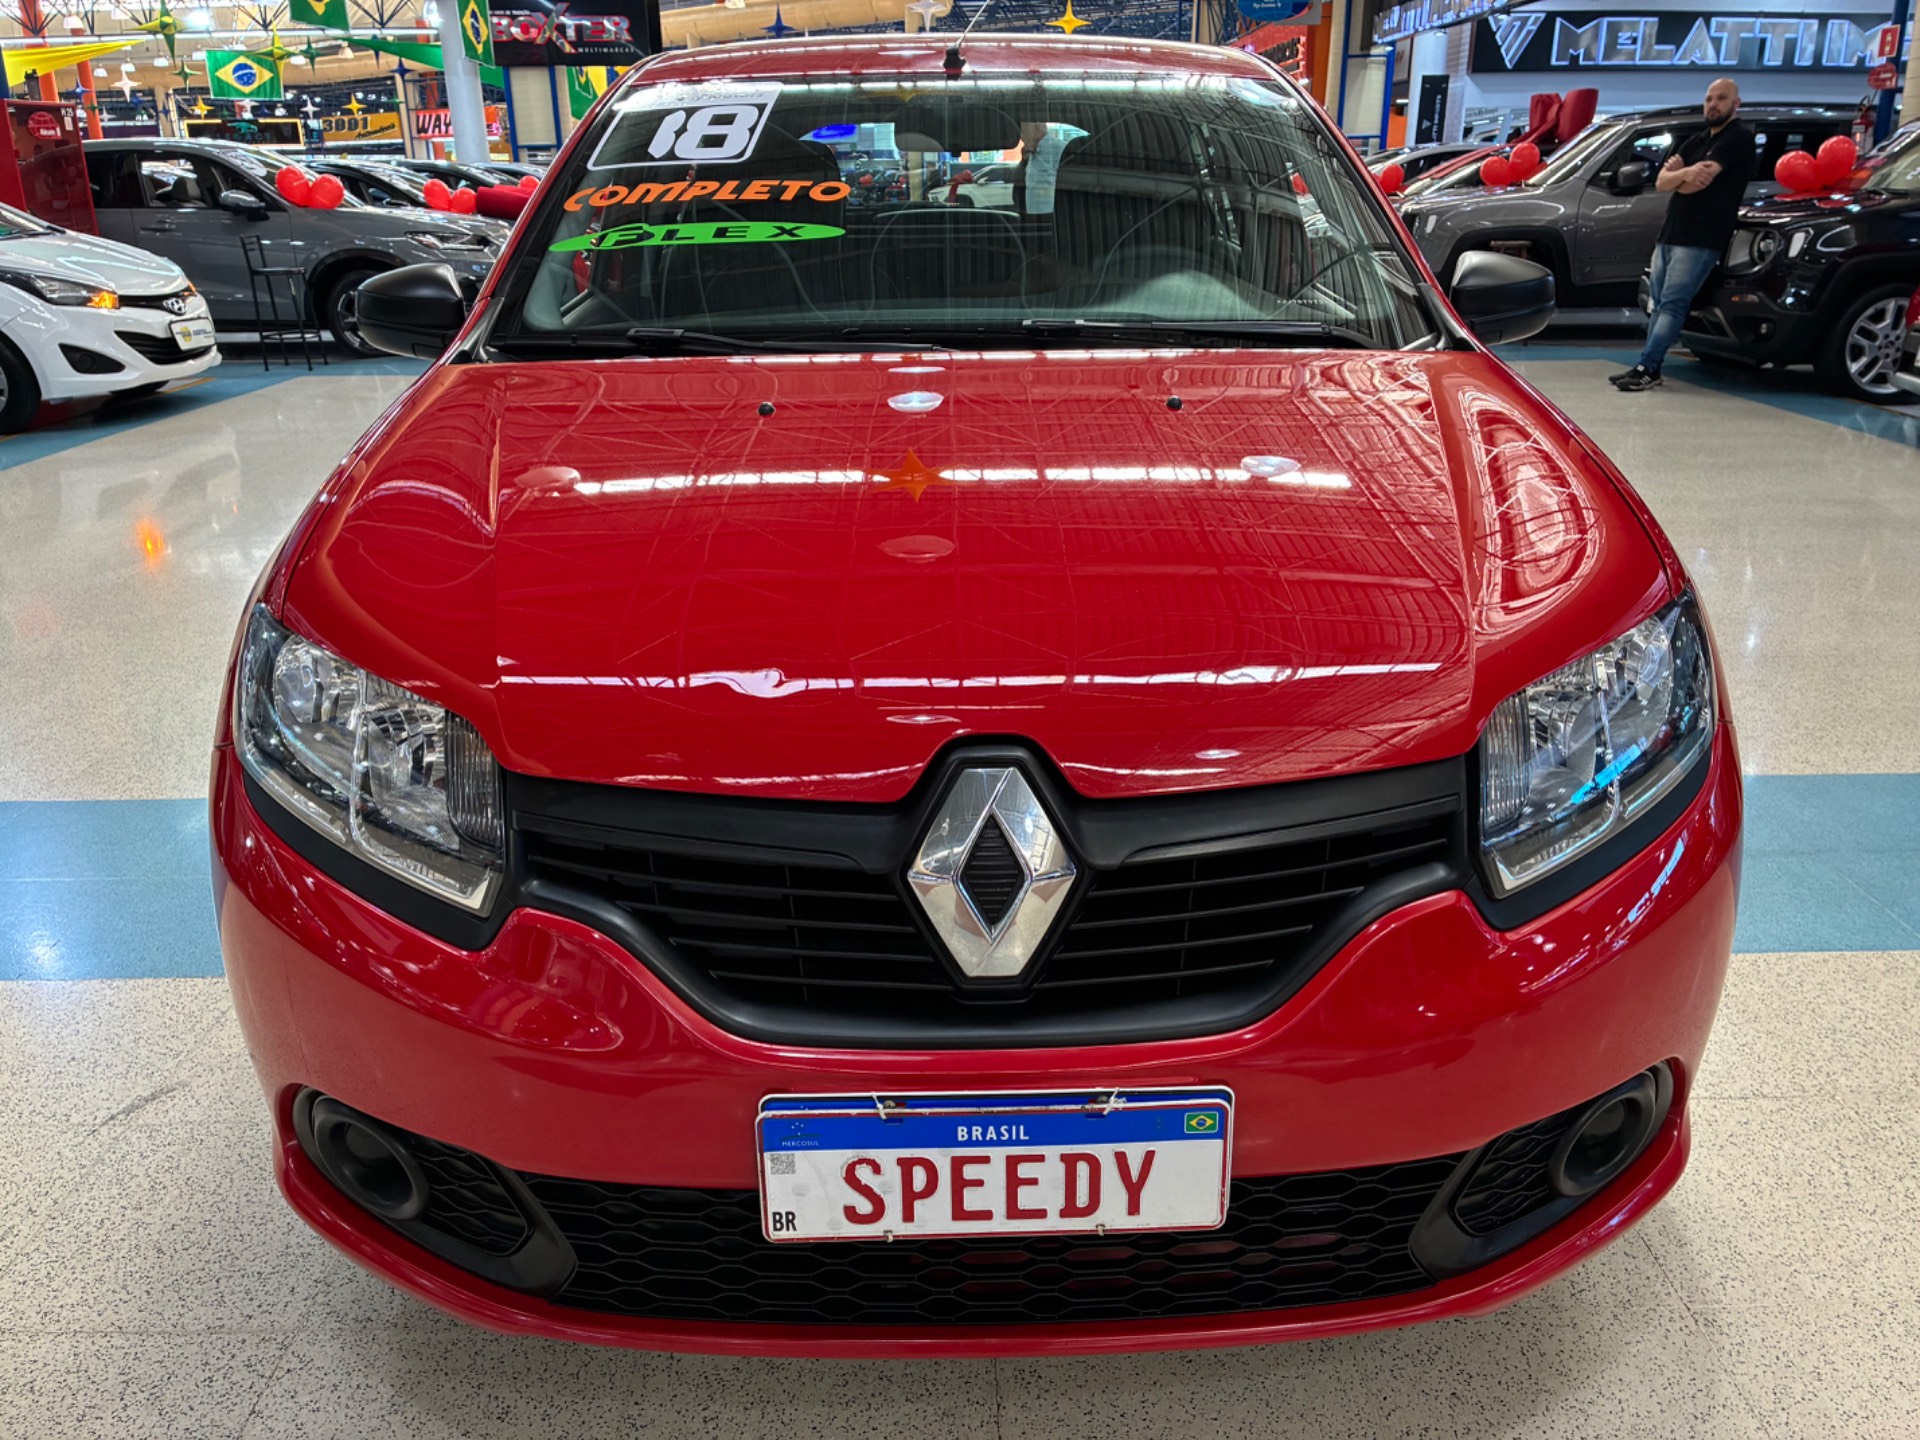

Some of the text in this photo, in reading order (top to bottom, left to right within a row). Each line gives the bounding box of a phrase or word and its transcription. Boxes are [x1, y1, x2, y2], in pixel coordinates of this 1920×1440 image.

[490, 2, 634, 53] BOXTER
[1551, 17, 1819, 66] MELATTI
[322, 116, 369, 132] 3001
[648, 104, 760, 159] 18
[563, 180, 851, 212] COMPLETO
[598, 225, 807, 247] FLEX
[957, 1125, 1030, 1141] BRASIL
[843, 1149, 1156, 1225] SPEEDY
[772, 1211, 797, 1232] BR
